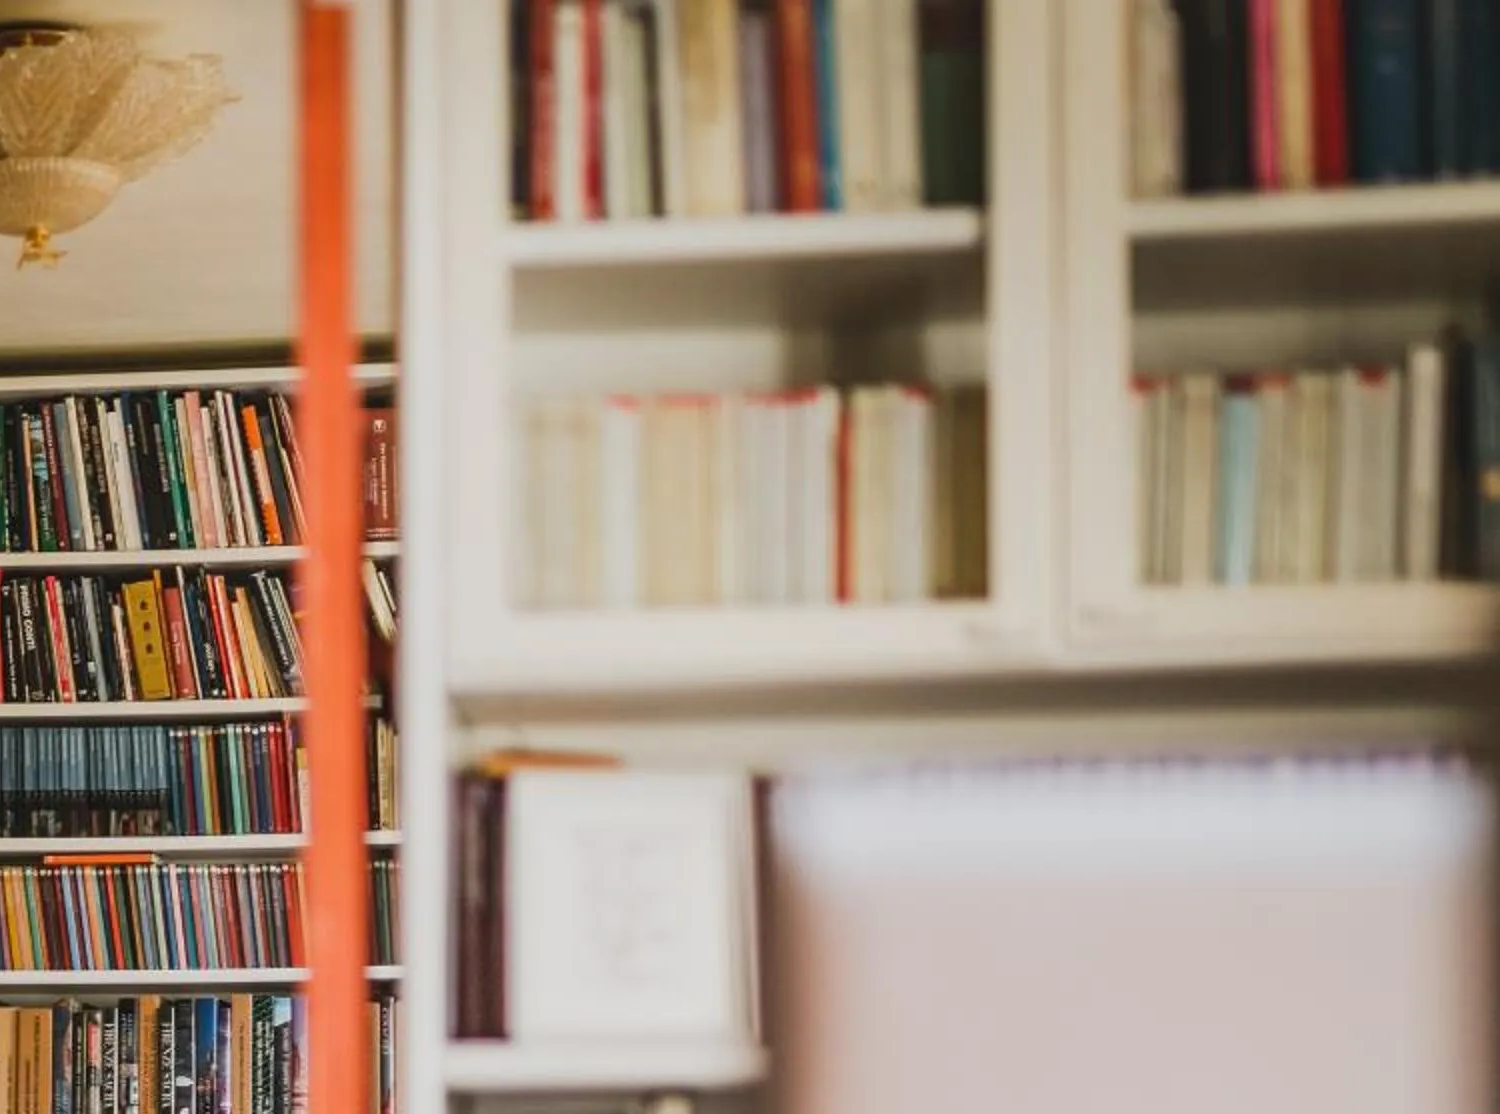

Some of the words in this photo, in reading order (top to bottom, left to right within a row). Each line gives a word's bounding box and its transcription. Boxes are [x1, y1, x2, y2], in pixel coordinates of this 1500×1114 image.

[23, 619, 37, 651] CONTI
[103, 1023, 115, 1068] FIRENZE
[161, 1023, 173, 1068] FIRENZE
